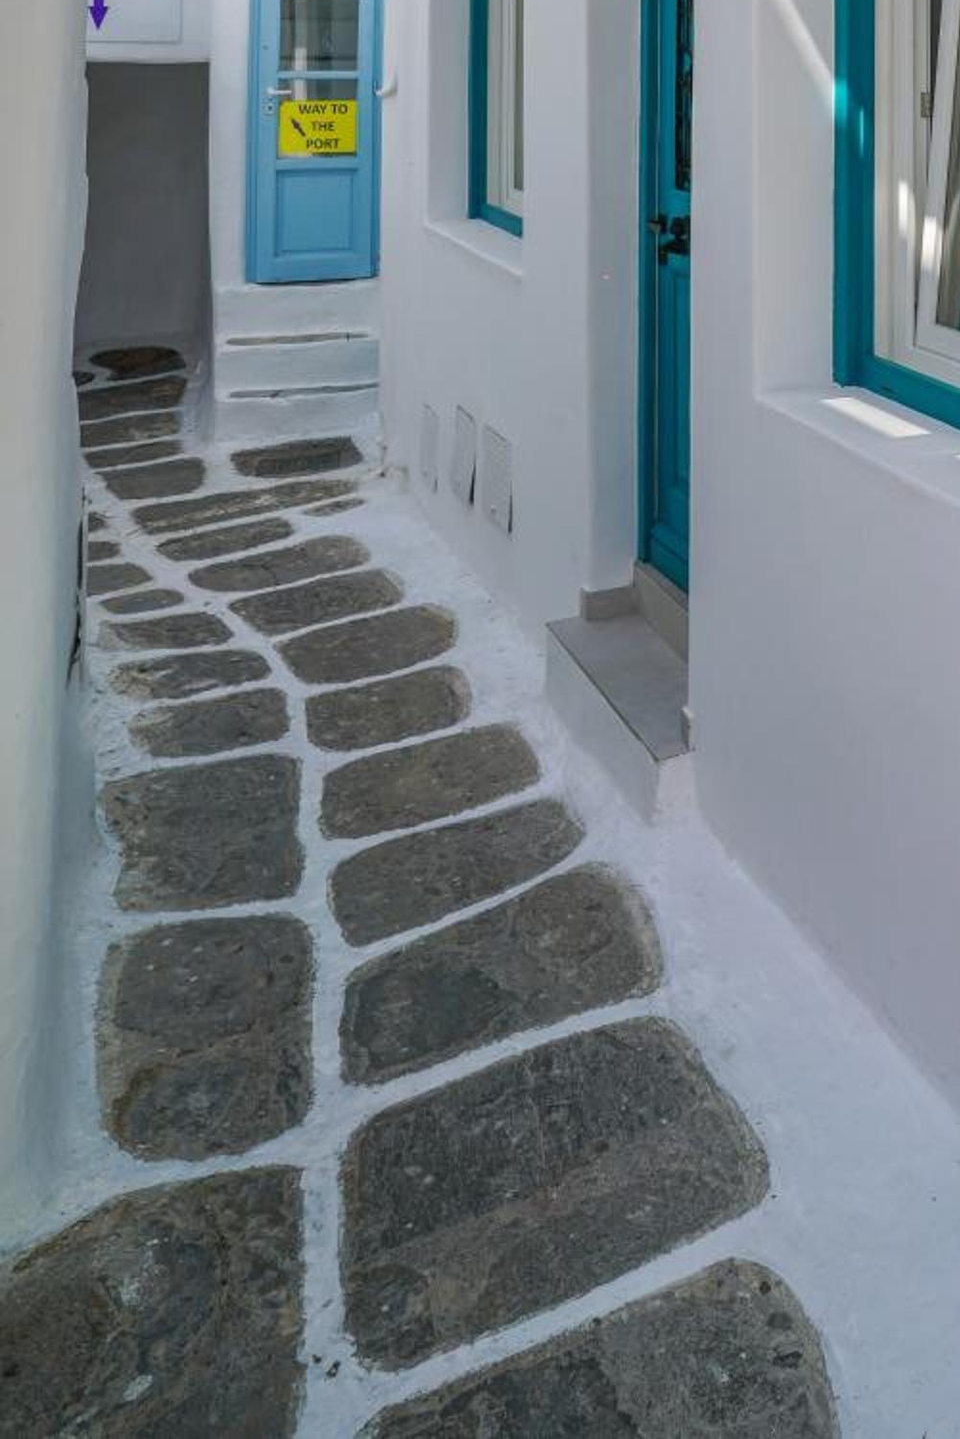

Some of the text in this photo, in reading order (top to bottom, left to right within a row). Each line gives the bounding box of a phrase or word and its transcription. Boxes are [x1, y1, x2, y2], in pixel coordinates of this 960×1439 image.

[298, 103, 349, 114] WAY TO
[310, 121, 336, 132] THE
[305, 138, 340, 150] PORT
